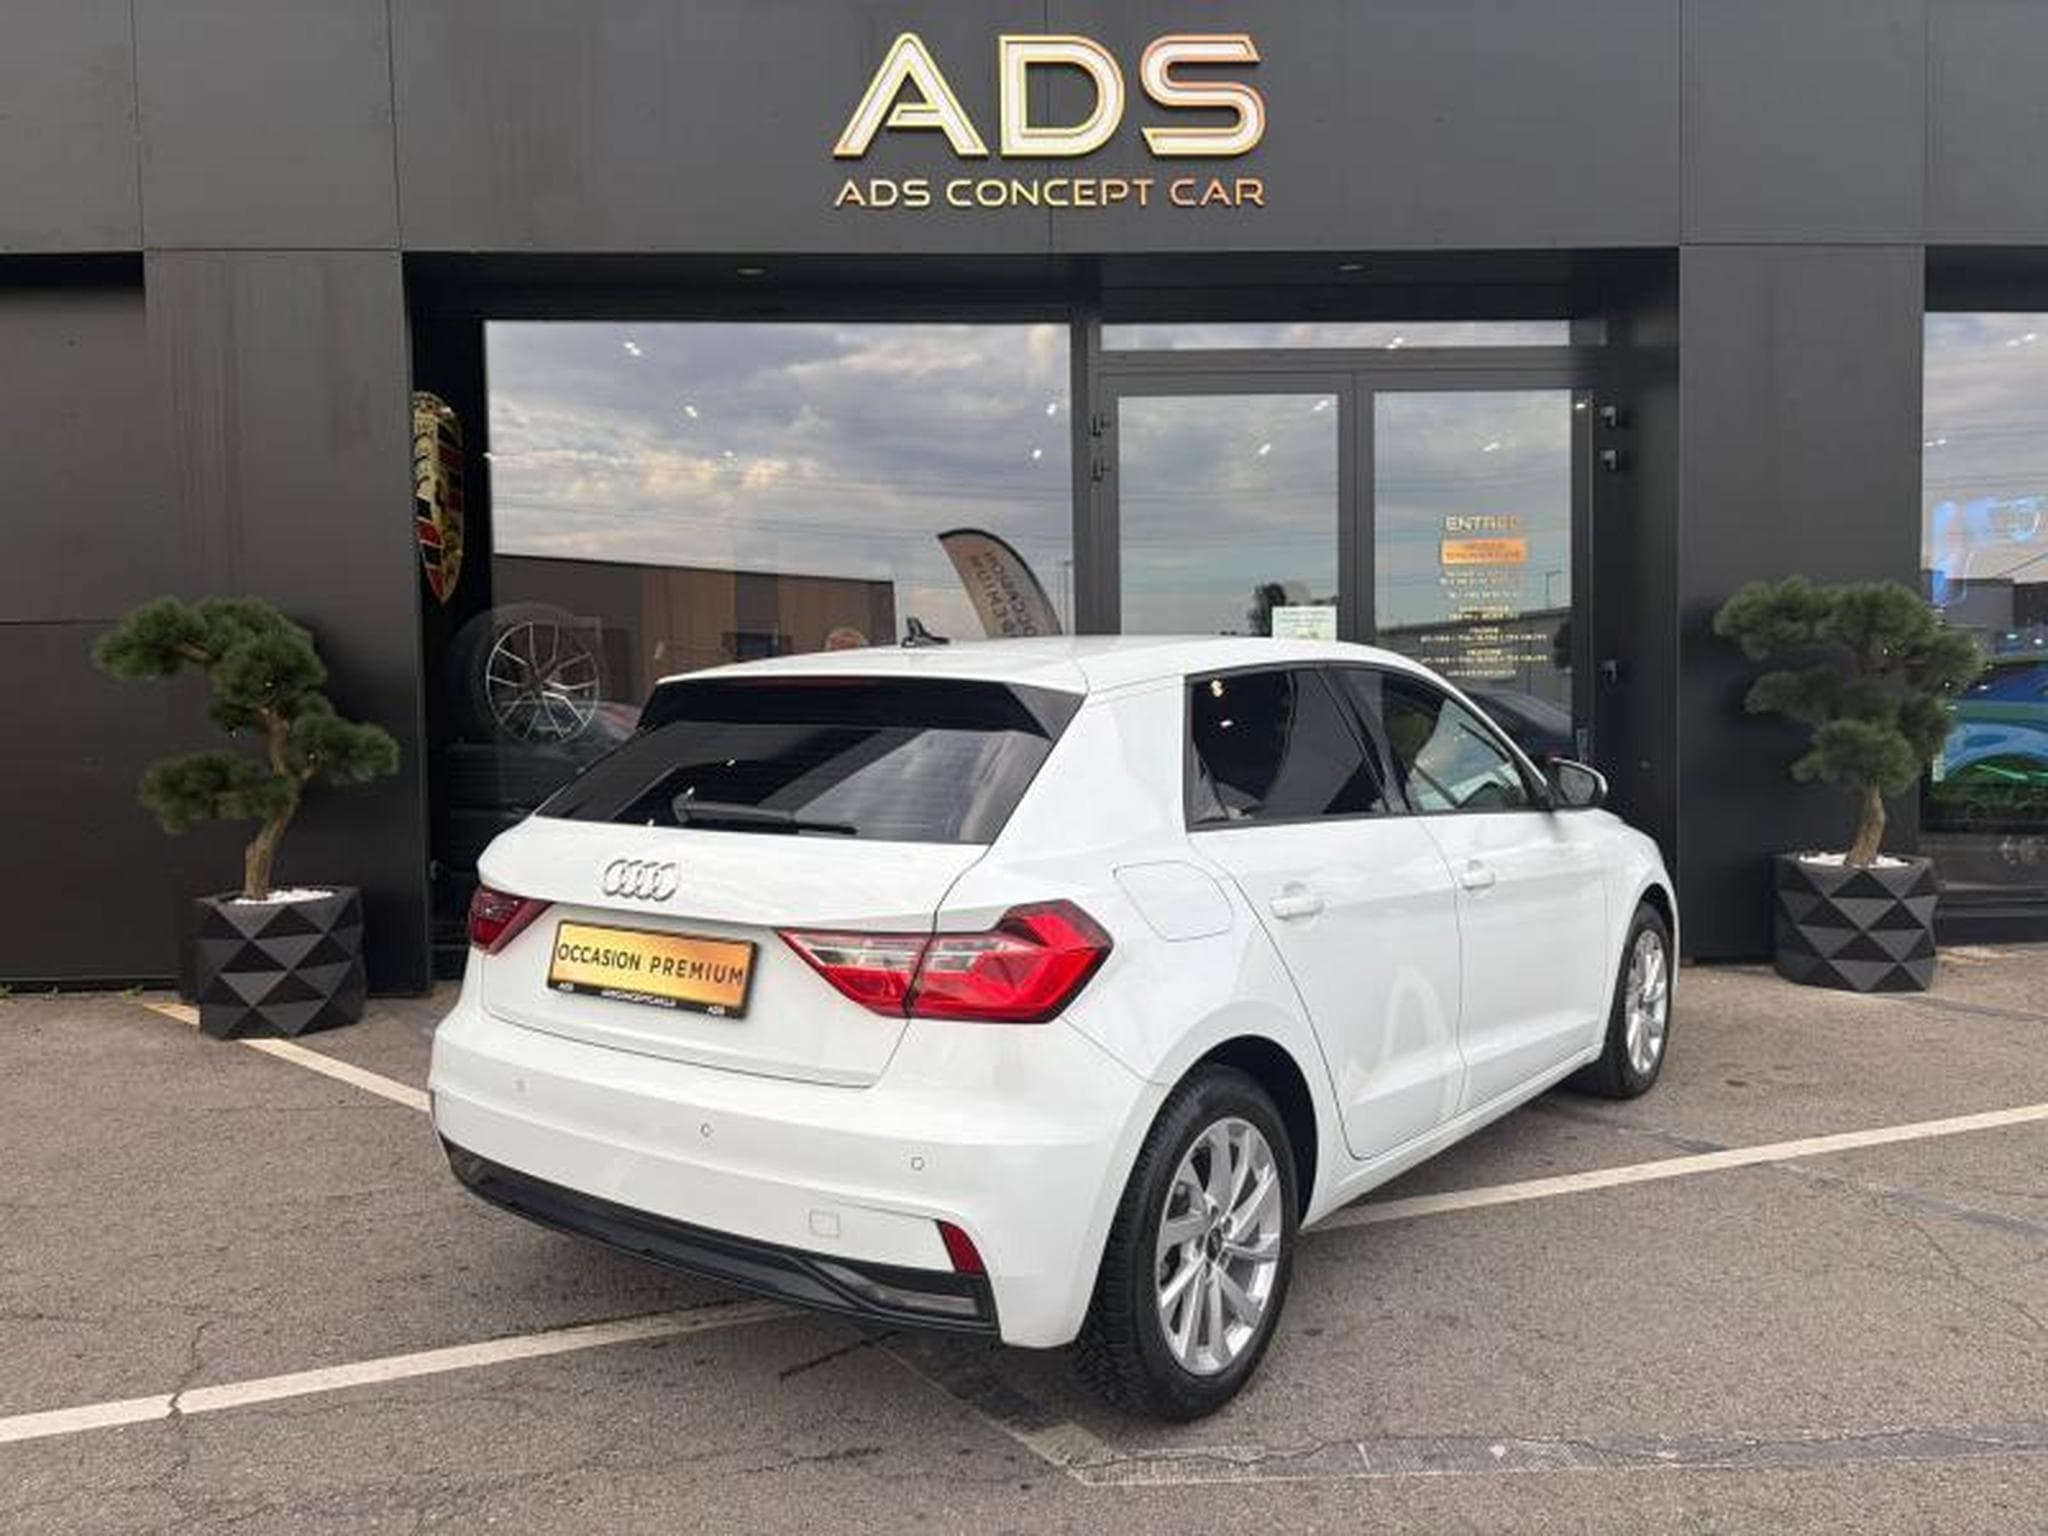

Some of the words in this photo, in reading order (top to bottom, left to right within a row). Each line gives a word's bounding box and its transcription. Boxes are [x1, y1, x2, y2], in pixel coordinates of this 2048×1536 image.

[833, 32, 1266, 156] ADS
[835, 180, 930, 207] ADS
[946, 179, 1154, 207] CONCEPT
[1169, 179, 1264, 207] CAR
[557, 943, 641, 971] OCCASION
[649, 955, 744, 986] PREMIUM
